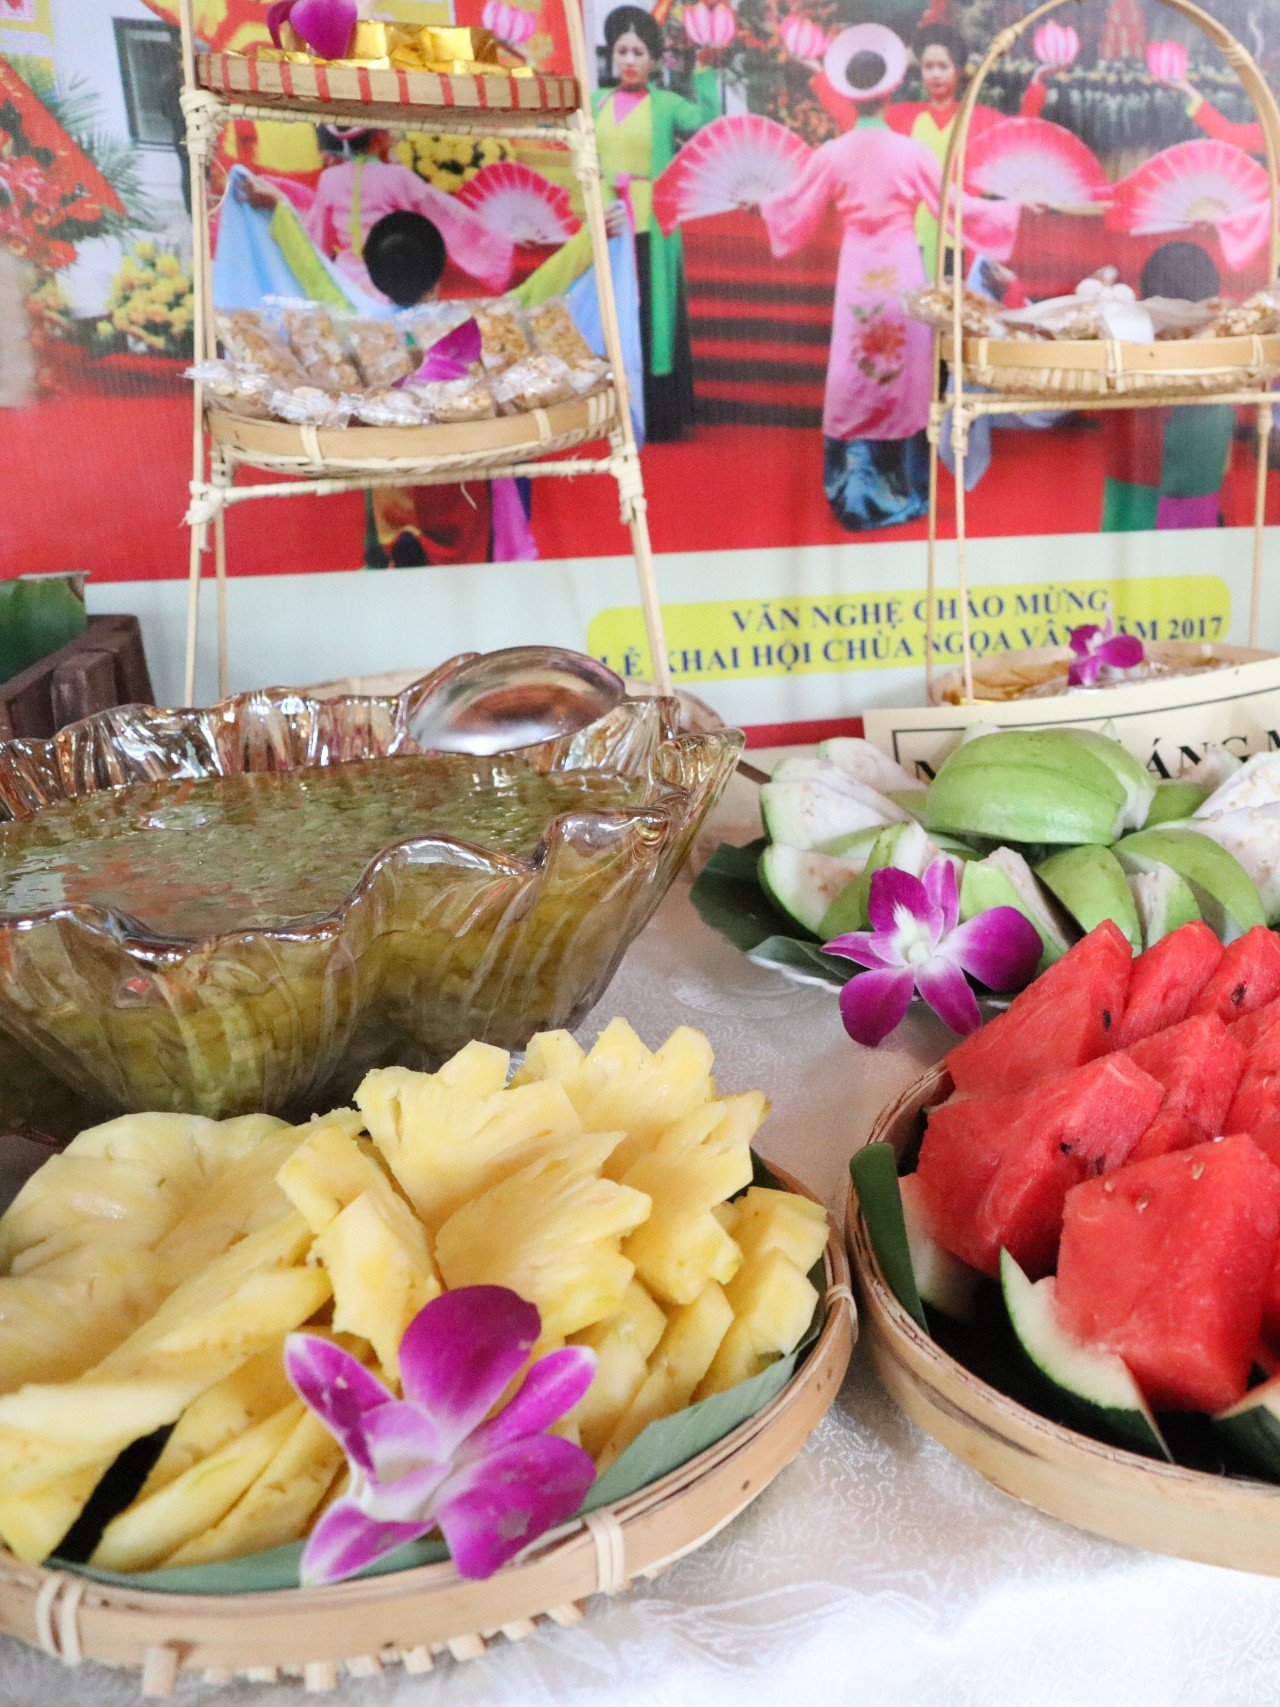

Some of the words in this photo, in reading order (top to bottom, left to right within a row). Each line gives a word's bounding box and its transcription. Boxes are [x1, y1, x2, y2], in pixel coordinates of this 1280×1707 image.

[731, 602, 800, 632] VĂN
[811, 598, 904, 630] NGHỆ
[1168, 616, 1224, 640] 2017
